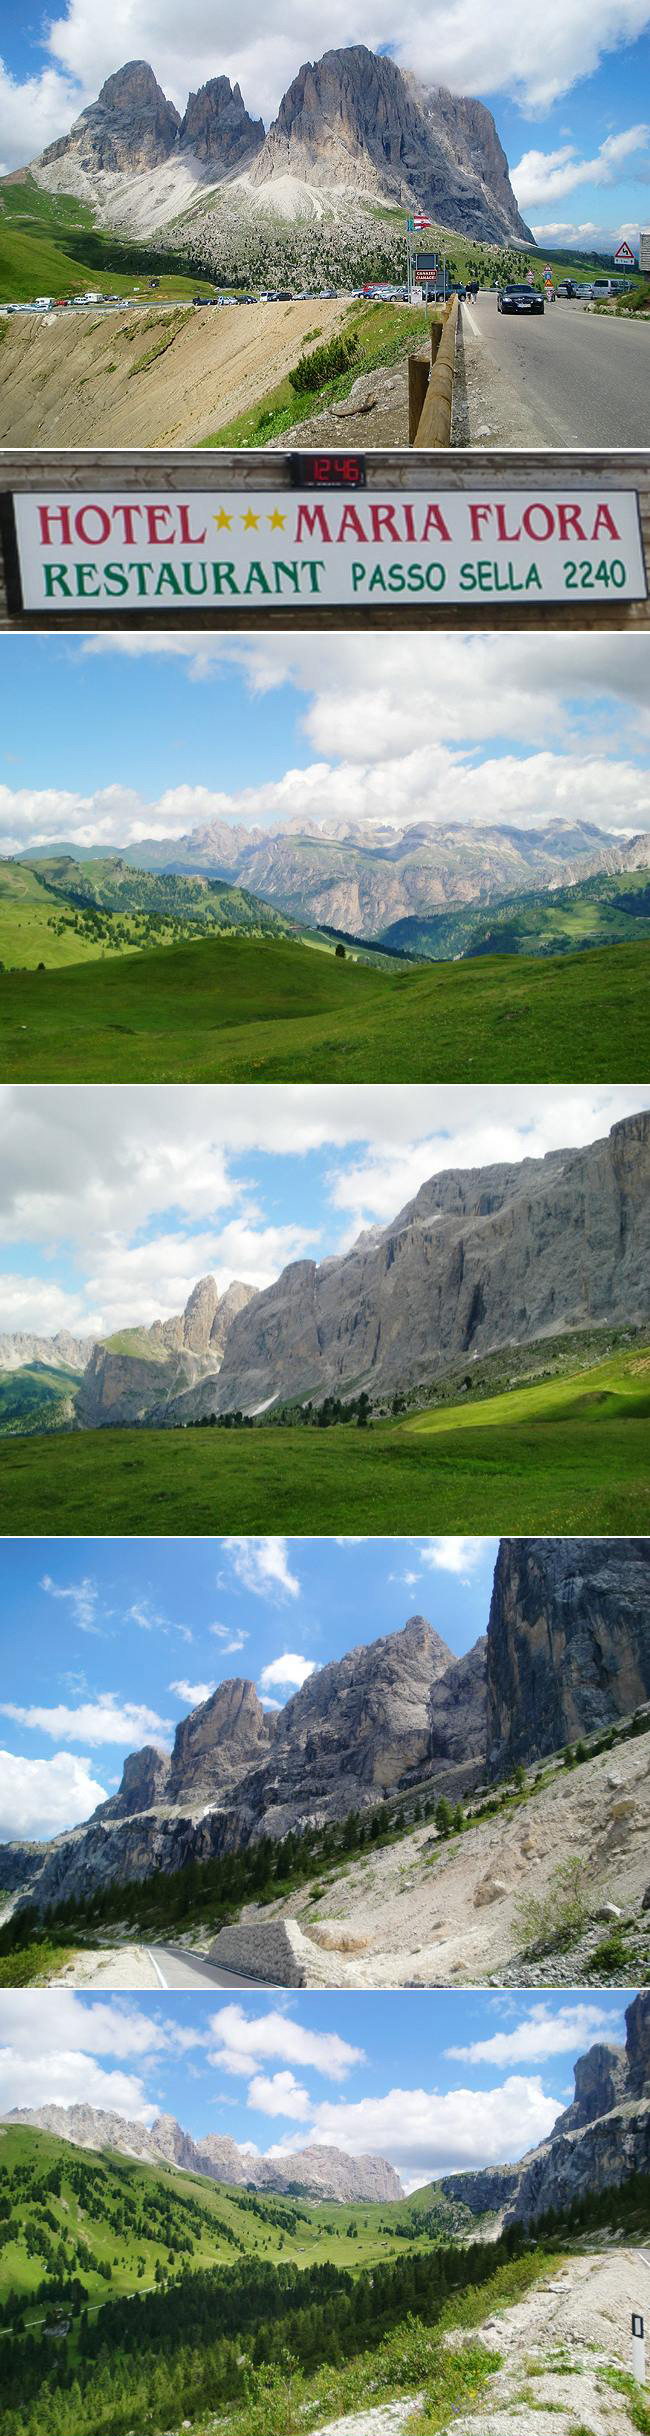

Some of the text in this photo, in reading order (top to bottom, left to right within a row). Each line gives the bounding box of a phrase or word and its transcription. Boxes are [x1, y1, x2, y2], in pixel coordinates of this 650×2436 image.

[37, 503, 620, 545] HOTEL MARIA FLORA
[43, 560, 626, 597] RESTAURANT PASSO SELLA 2240
